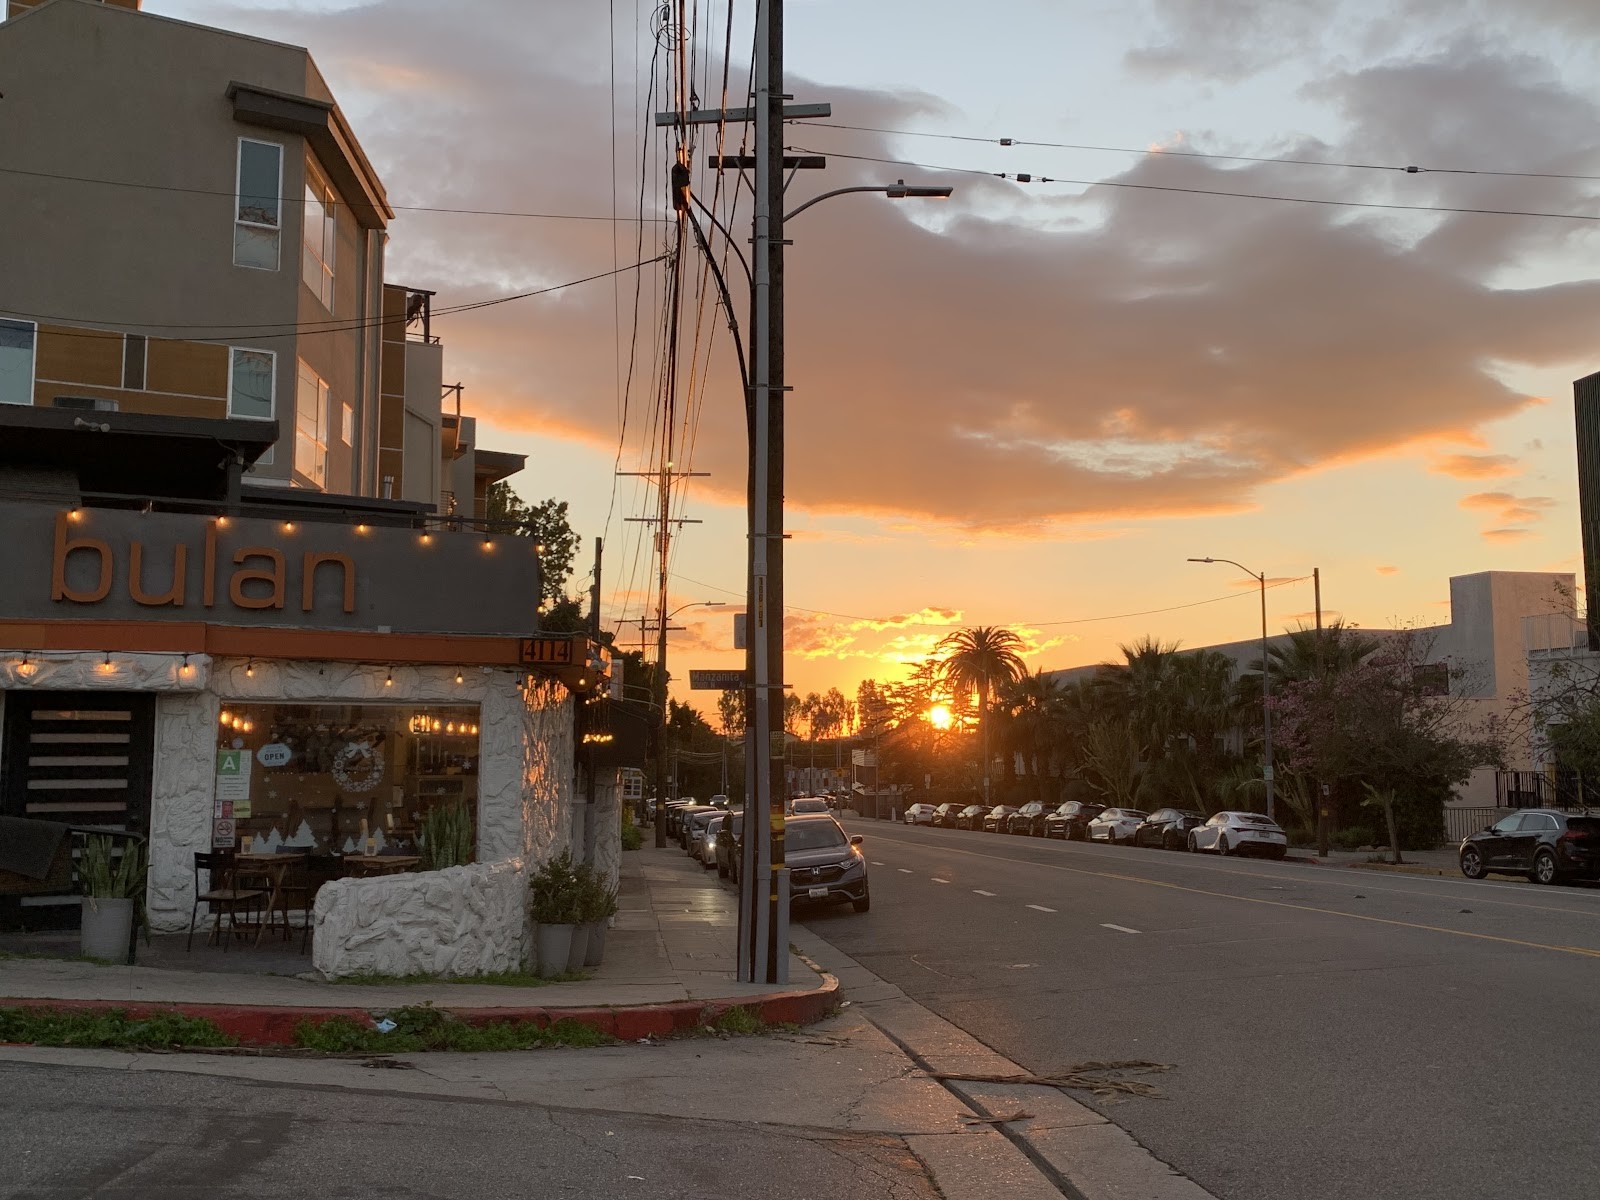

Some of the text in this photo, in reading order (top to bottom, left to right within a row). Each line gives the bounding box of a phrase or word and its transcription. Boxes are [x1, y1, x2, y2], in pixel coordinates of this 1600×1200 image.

[52, 511, 356, 613] bulan
[524, 640, 569, 661] 4114
[693, 671, 739, 681] Manzanita
[222, 755, 236, 769] A
[264, 752, 285, 760] OPEN
